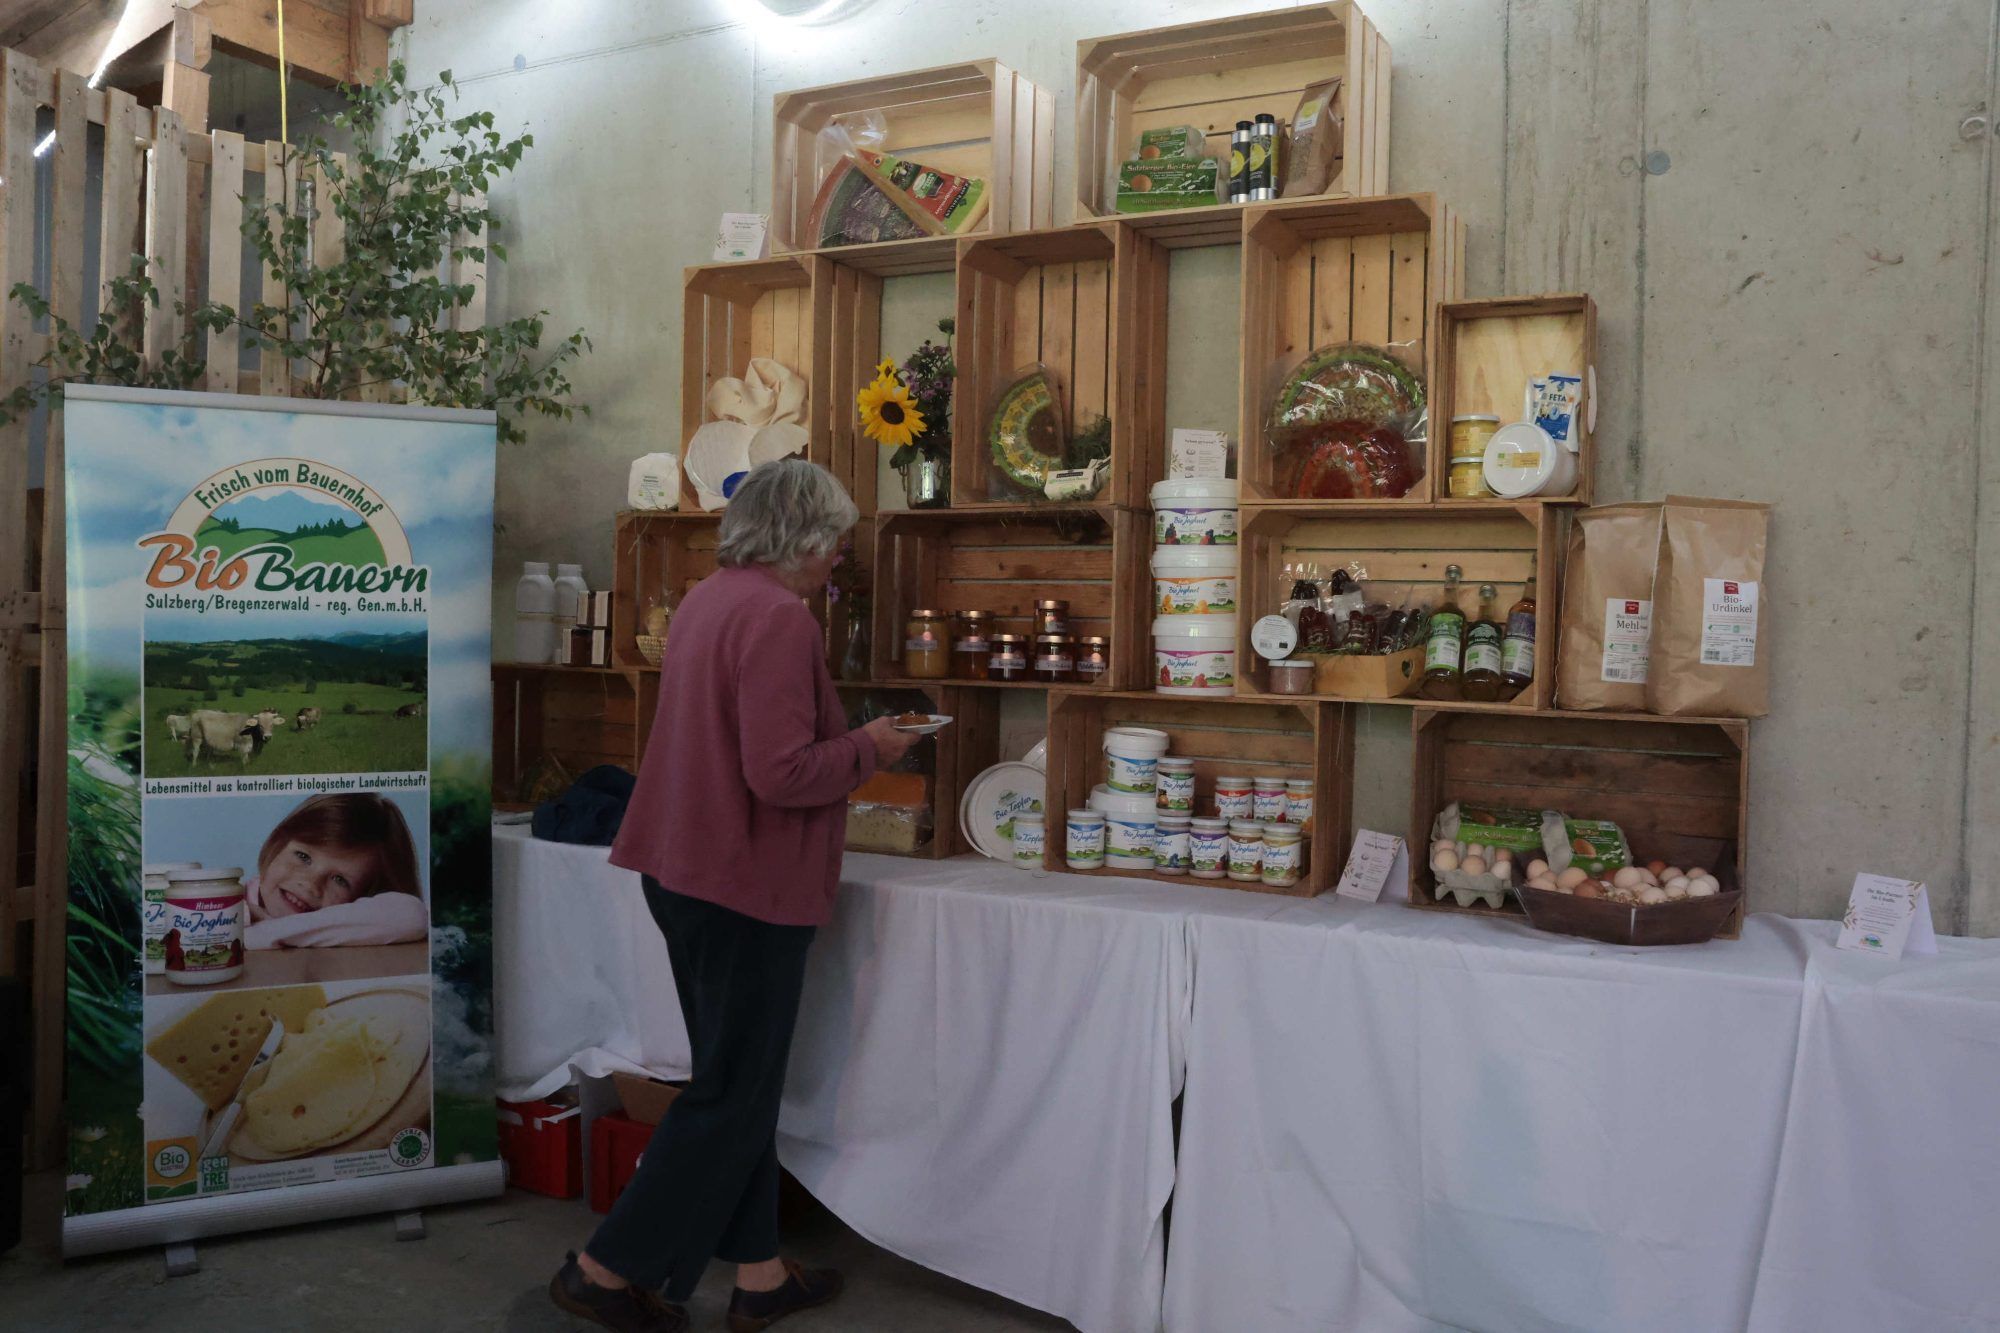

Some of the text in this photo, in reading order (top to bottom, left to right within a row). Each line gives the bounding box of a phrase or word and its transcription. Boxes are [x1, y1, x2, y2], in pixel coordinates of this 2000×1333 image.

[1549, 393, 1567, 402] FETA
[194, 463, 384, 518] Frisch vom Bauernhof
[138, 533, 429, 594] Bio Bauern
[145, 593, 310, 613] Sulzberg/Bregenzerwald
[327, 600, 351, 614] reg.
[357, 597, 427, 613] Gen.m.b.H.
[1723, 595, 1743, 604] Bio-
[1712, 604, 1753, 614] Urdinkel
[1616, 620, 1640, 630] Mehl
[145, 774, 427, 795] Lebensmittel aus kontrolliert biologischer Landwirtschaft
[993, 807, 1009, 820] Bio
[173, 911, 239, 933] Bio Joghurt
[160, 1152, 185, 1166] Bio
[203, 1171, 228, 1186] FREI
